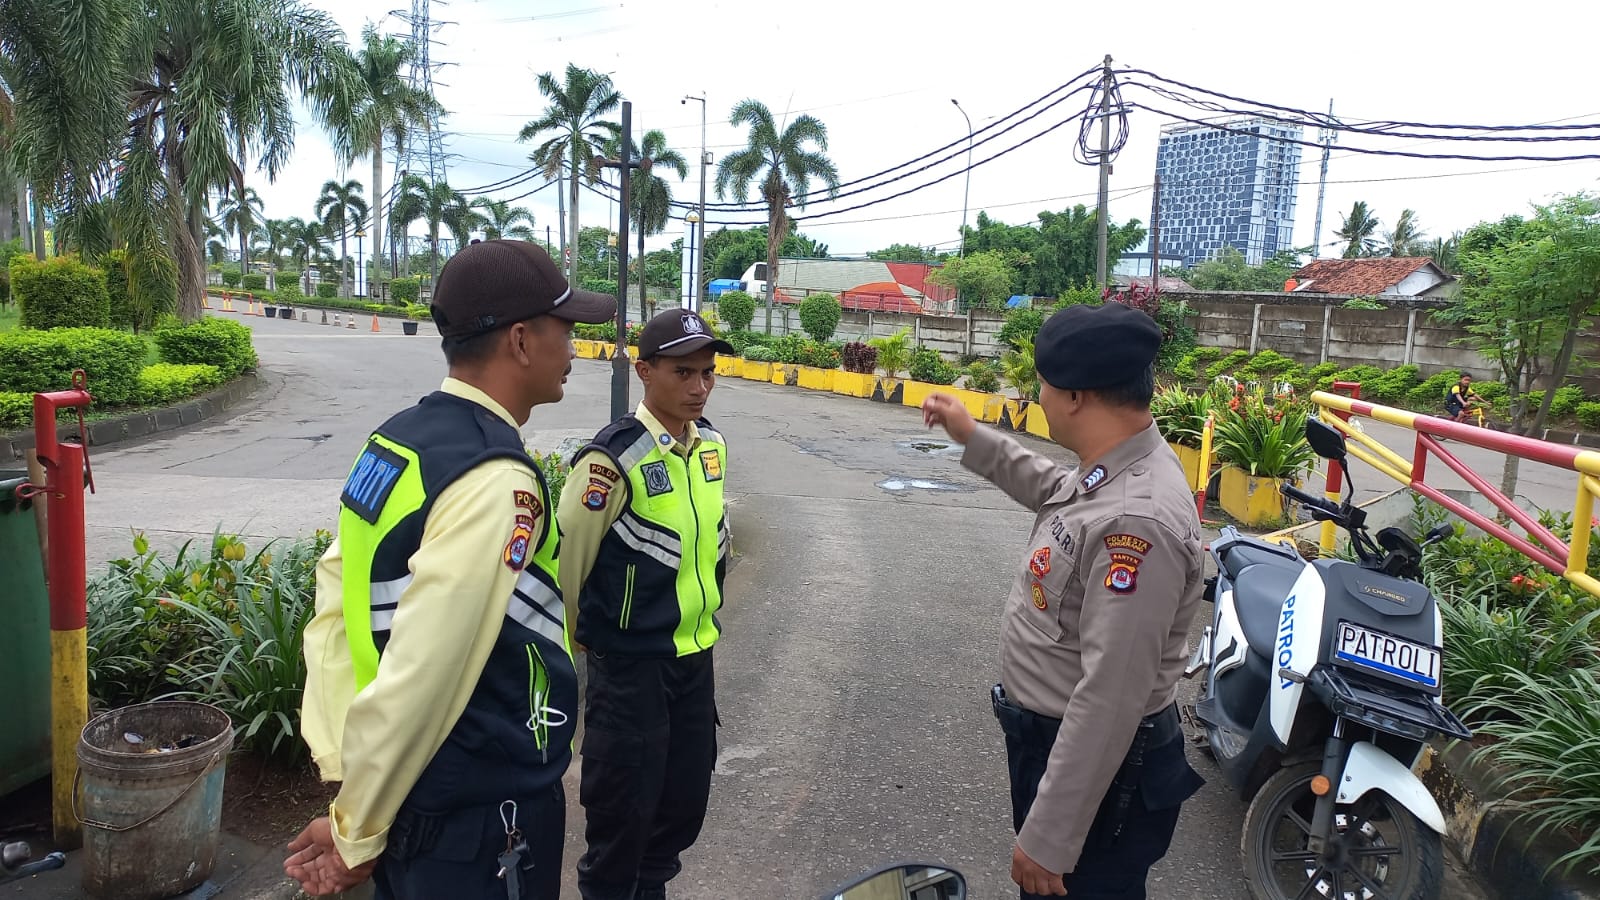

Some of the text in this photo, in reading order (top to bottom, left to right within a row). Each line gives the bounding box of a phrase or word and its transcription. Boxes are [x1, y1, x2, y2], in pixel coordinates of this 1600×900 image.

[591, 465, 617, 481] POLDA
[517, 493, 540, 517] POLDA
[1050, 515, 1076, 555] POLRI
[1106, 535, 1148, 550] POLRESTA
[1113, 554, 1139, 564] BANTEN
[1341, 626, 1436, 678] PATROLI
